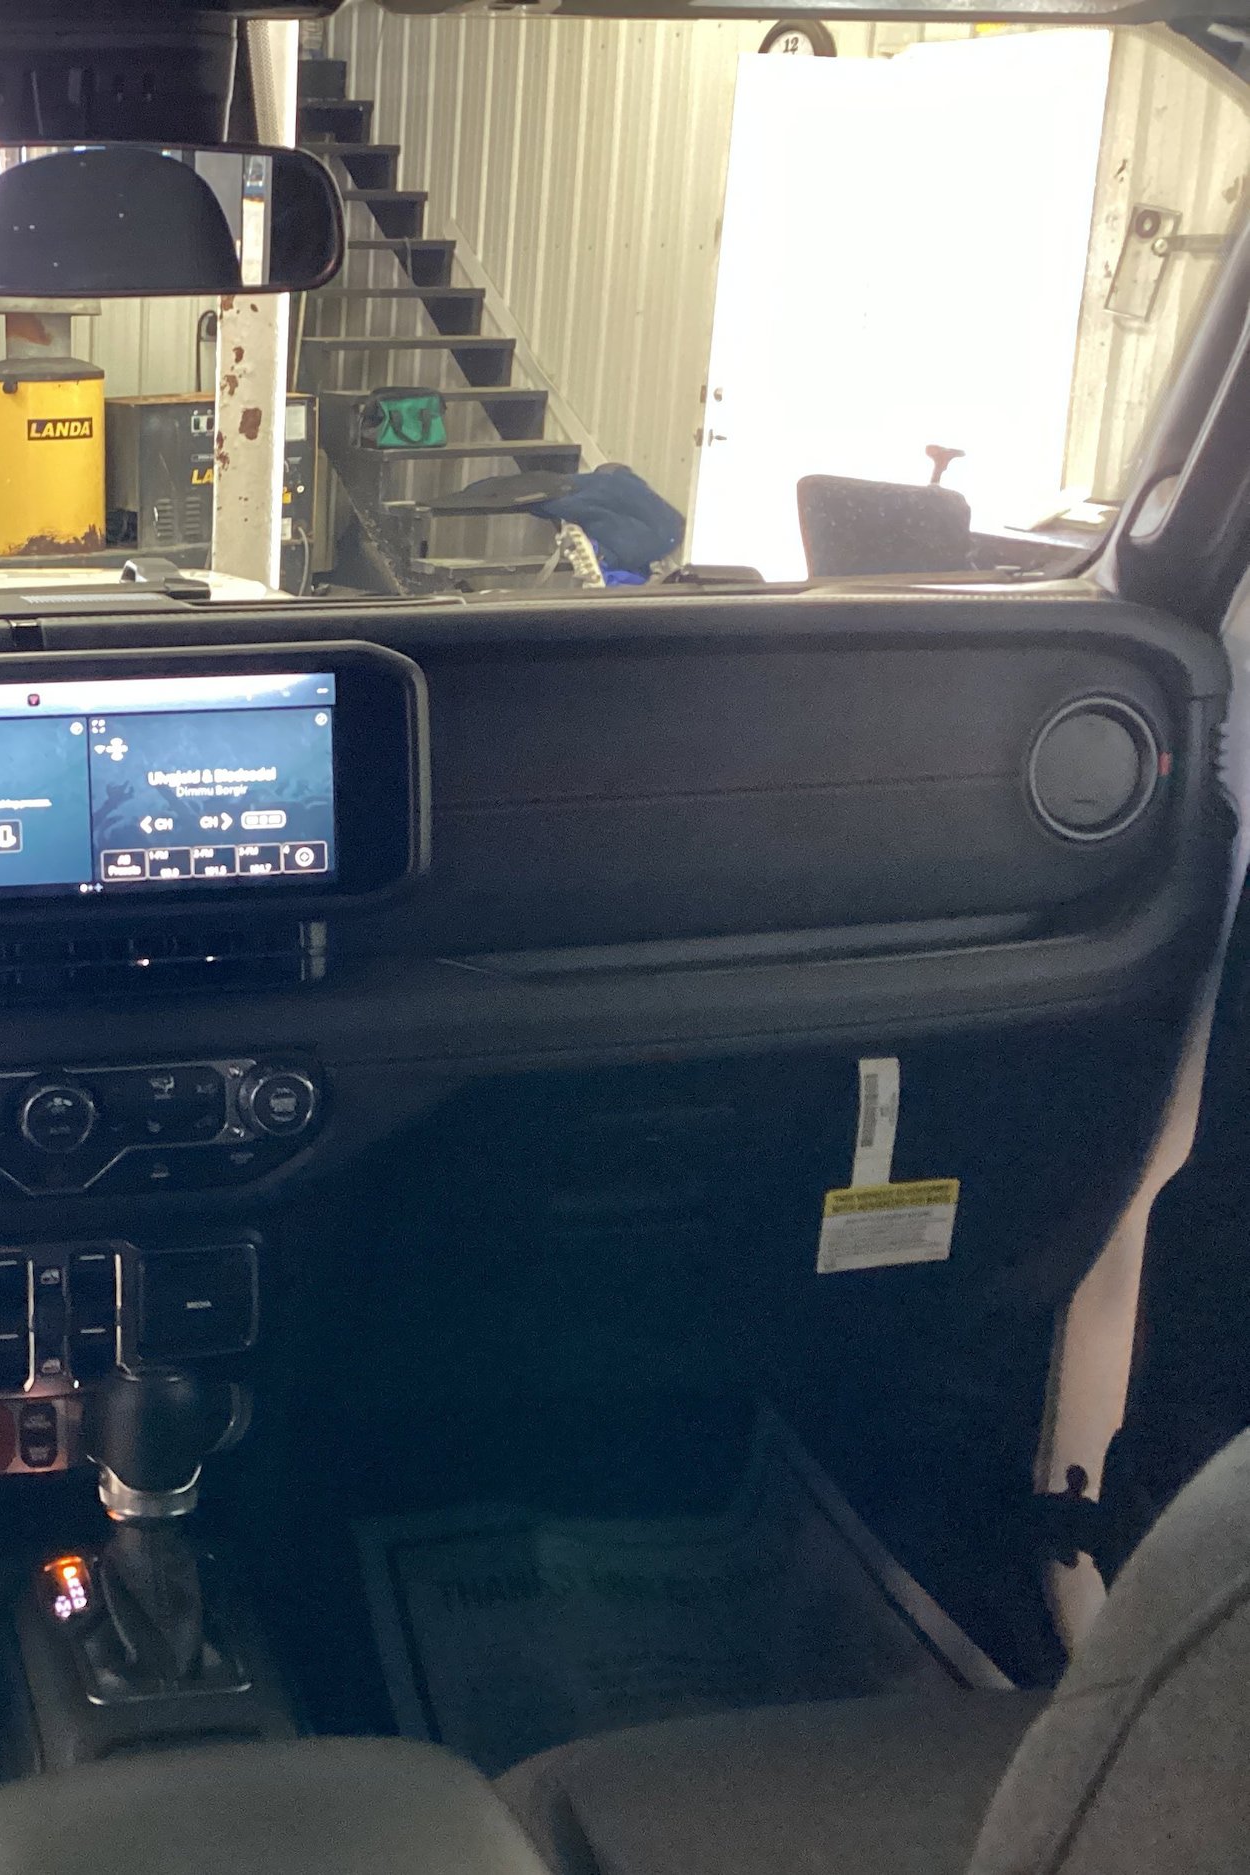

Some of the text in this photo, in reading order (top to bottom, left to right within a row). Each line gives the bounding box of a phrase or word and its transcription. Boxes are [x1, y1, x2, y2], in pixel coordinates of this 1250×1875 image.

[30, 421, 90, 438] LANDA
[202, 769, 212, 783] &
[176, 784, 248, 798] Dimmu Borgir
[154, 818, 173, 830] CH
[200, 816, 218, 829] CH
